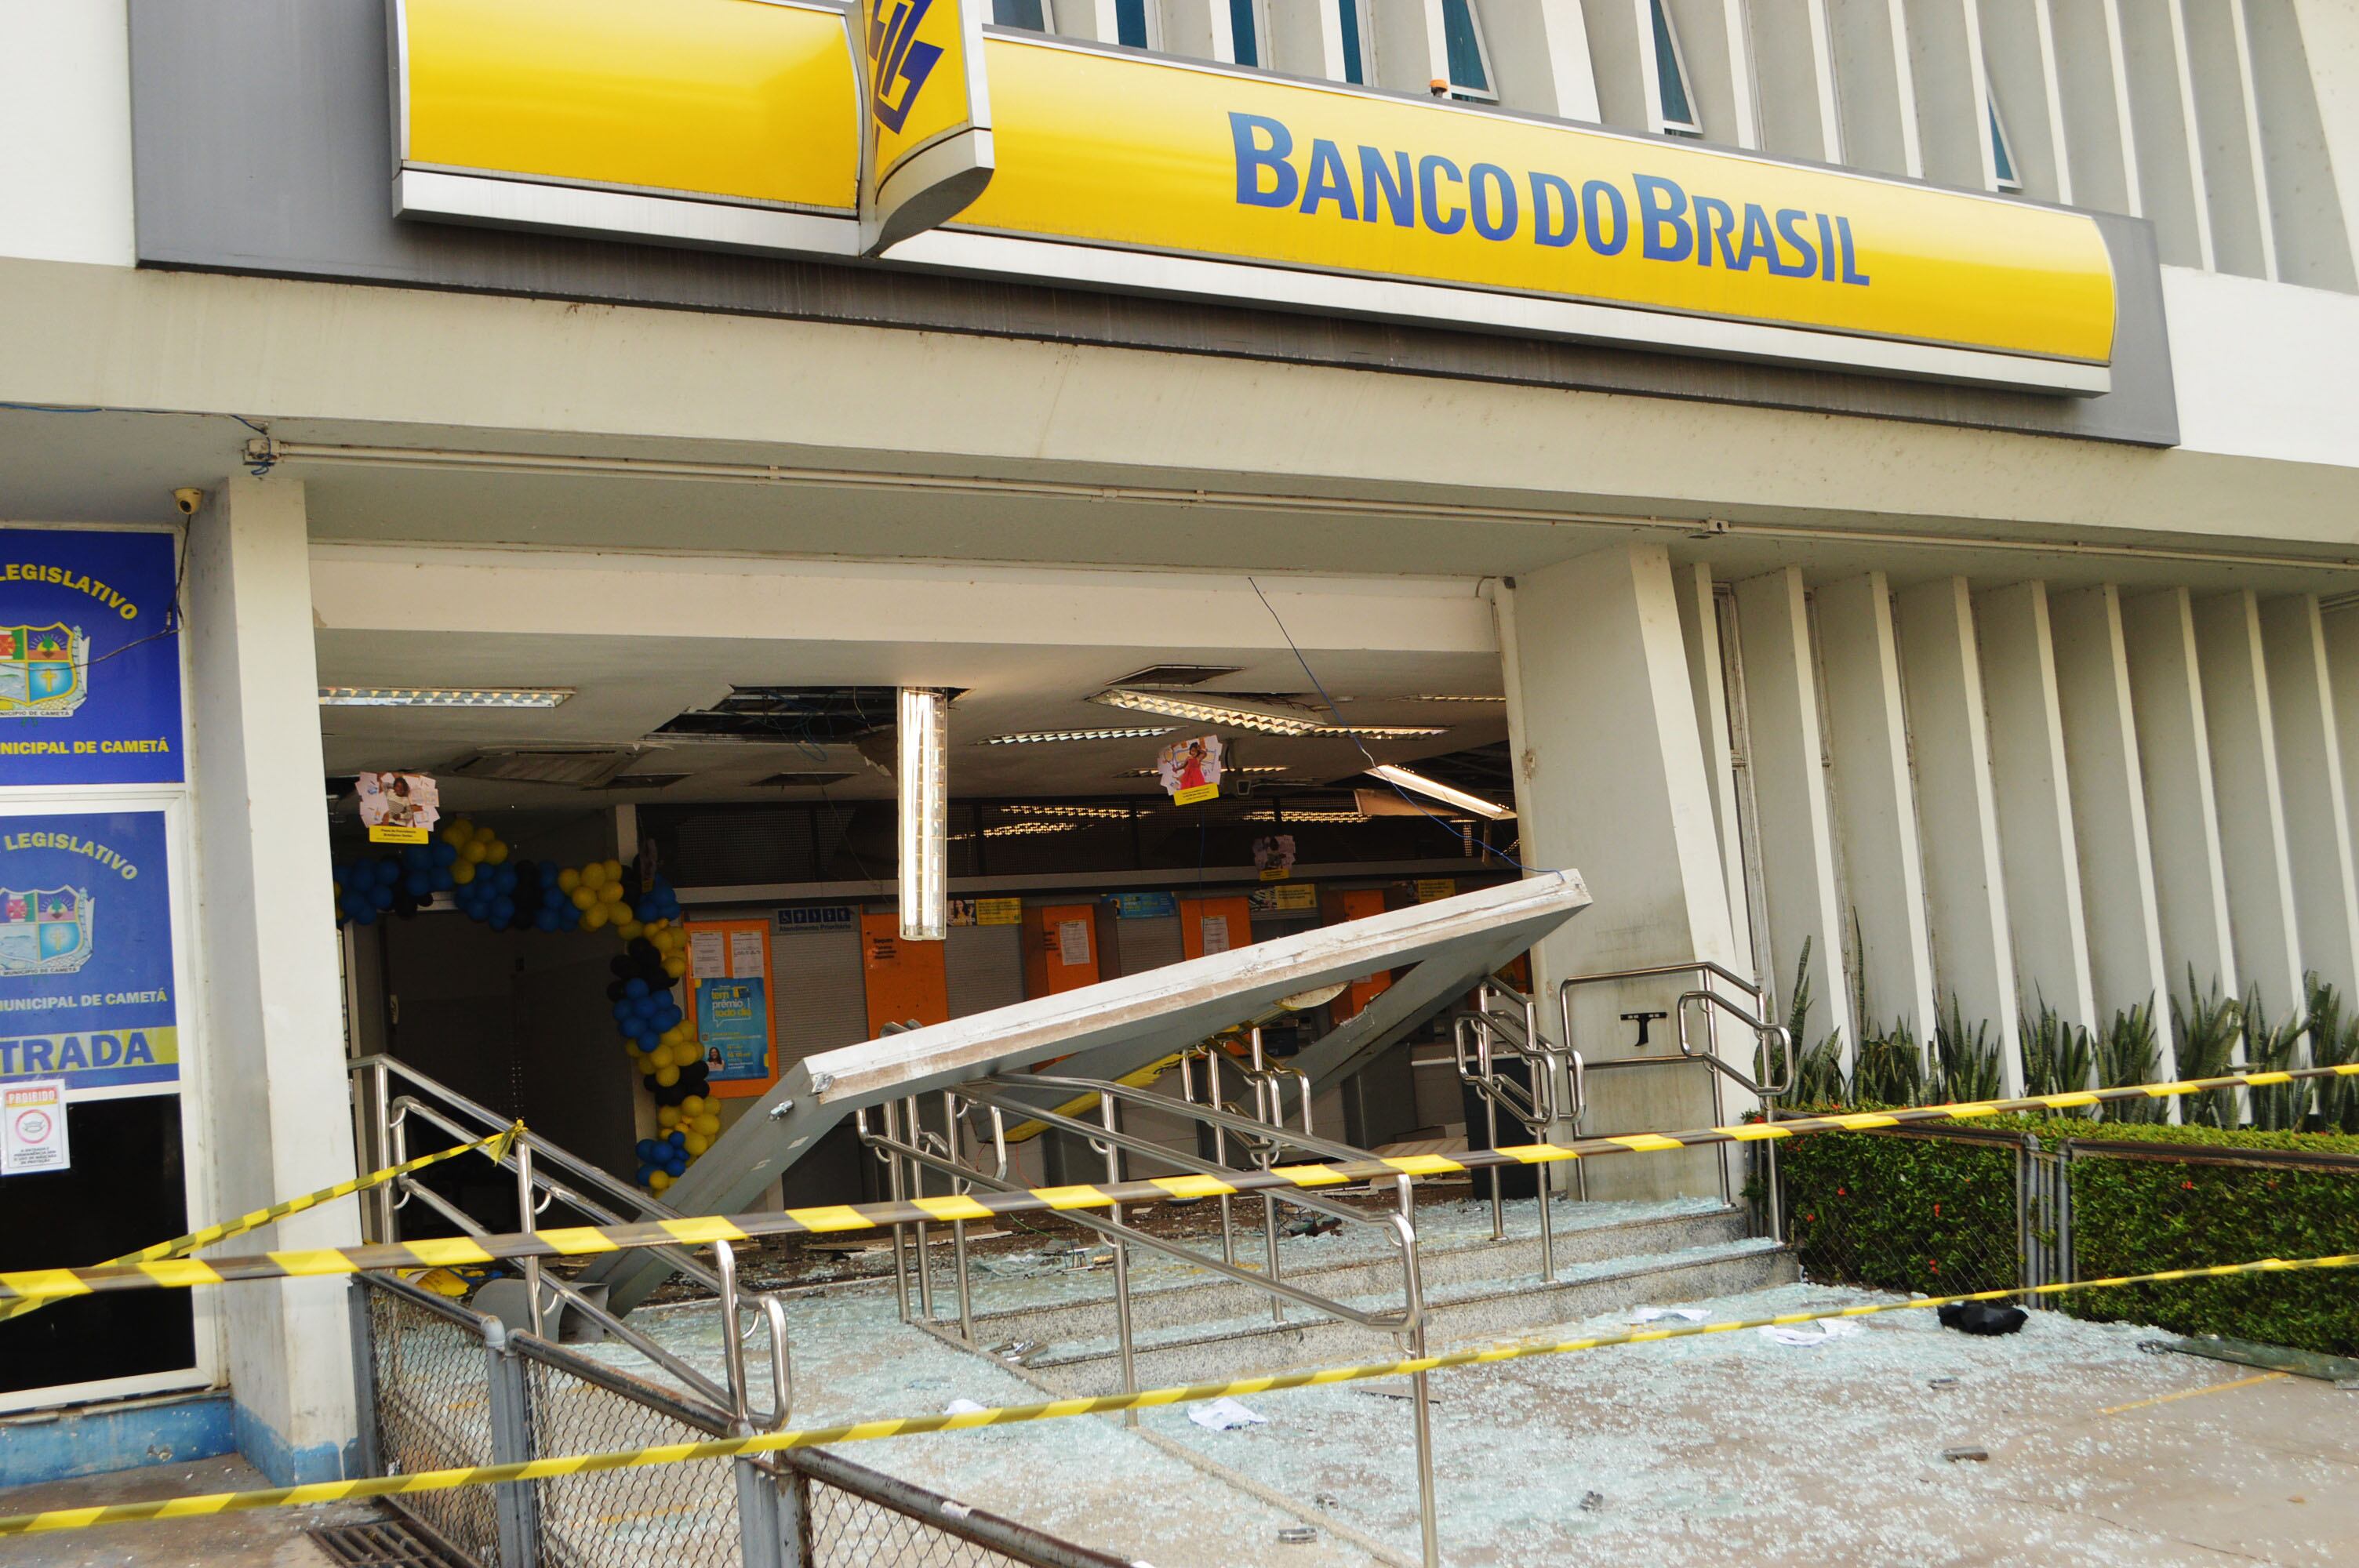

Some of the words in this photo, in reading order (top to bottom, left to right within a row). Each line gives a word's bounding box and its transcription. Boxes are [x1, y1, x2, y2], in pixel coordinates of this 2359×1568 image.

[1228, 111, 1518, 241] BANCO
[1528, 171, 1629, 256] DO
[1632, 173, 1870, 287] BRASIL
[74, 741, 97, 753] DE
[101, 736, 169, 753] CAMETÁ
[4, 832, 138, 880] LEGISLATIVO
[82, 994, 102, 1007] DE
[105, 987, 167, 1005] CAMETÁ
[8, 1090, 55, 1105] PROIBIDO
